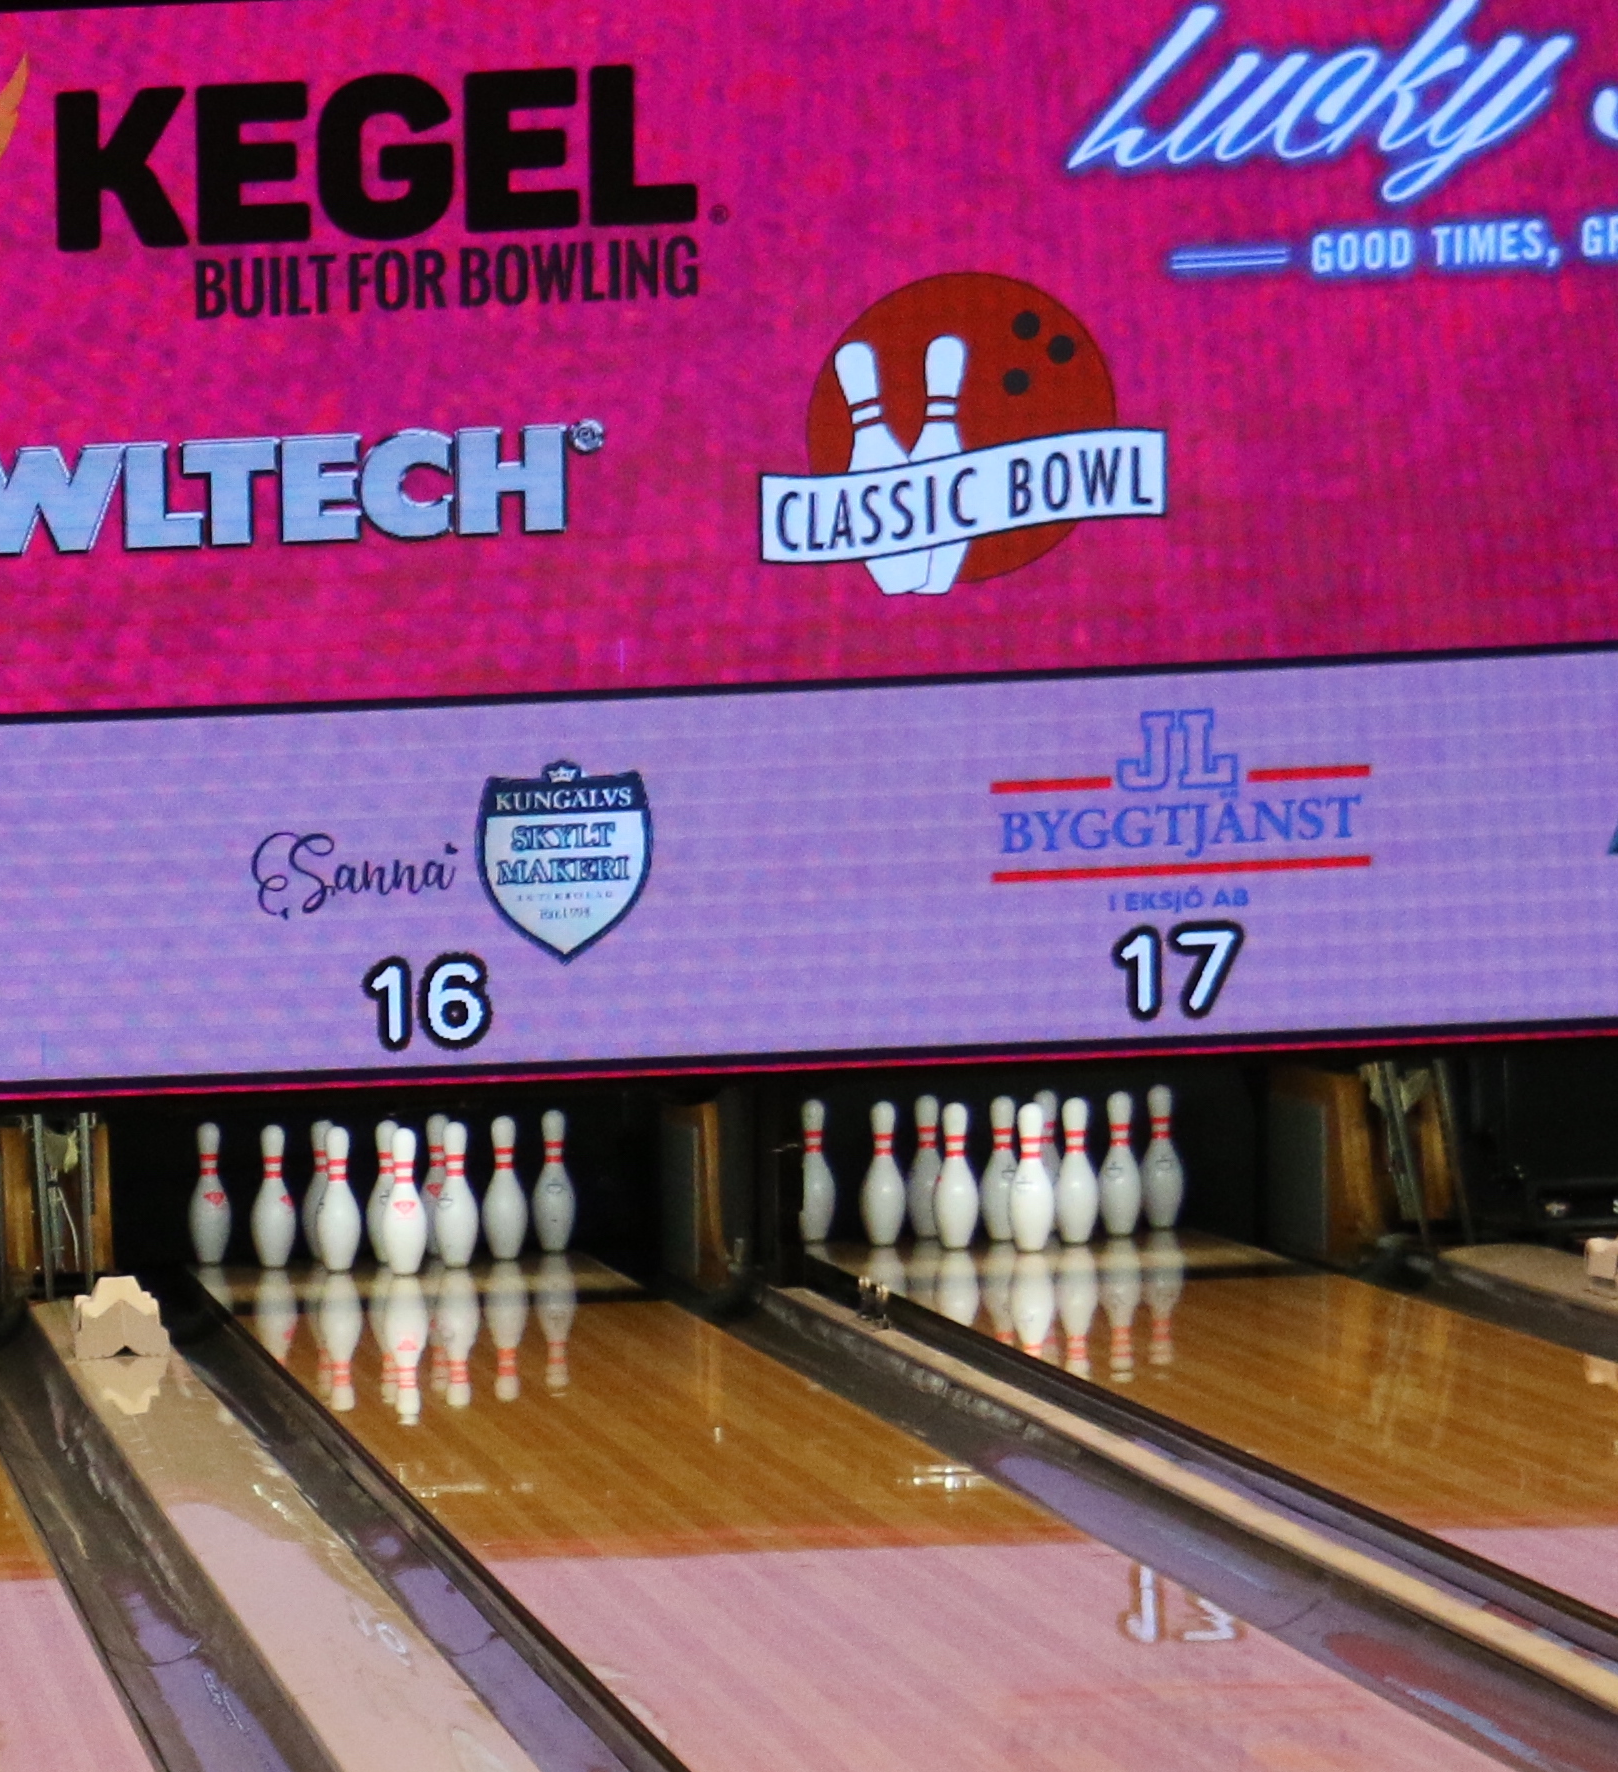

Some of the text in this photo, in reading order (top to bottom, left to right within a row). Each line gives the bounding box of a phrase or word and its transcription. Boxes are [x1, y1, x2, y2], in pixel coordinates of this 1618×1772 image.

[1068, 0, 1574, 203] Lucky
[193, 236, 698, 320] BUILT FOR BOWLING
[1311, 232, 1412, 273] GOOD
[1430, 218, 1561, 268] TIMES,
[775, 444, 1153, 553] CLASSIC BOWL
[1115, 708, 1239, 793] JL
[511, 822, 616, 852] SKYLT
[999, 790, 1363, 857] BYGGTJÄNST
[496, 855, 630, 886] MAKERI
[1213, 888, 1249, 908] AB
[363, 952, 492, 1050] 16
[1112, 920, 1244, 1019] 17
